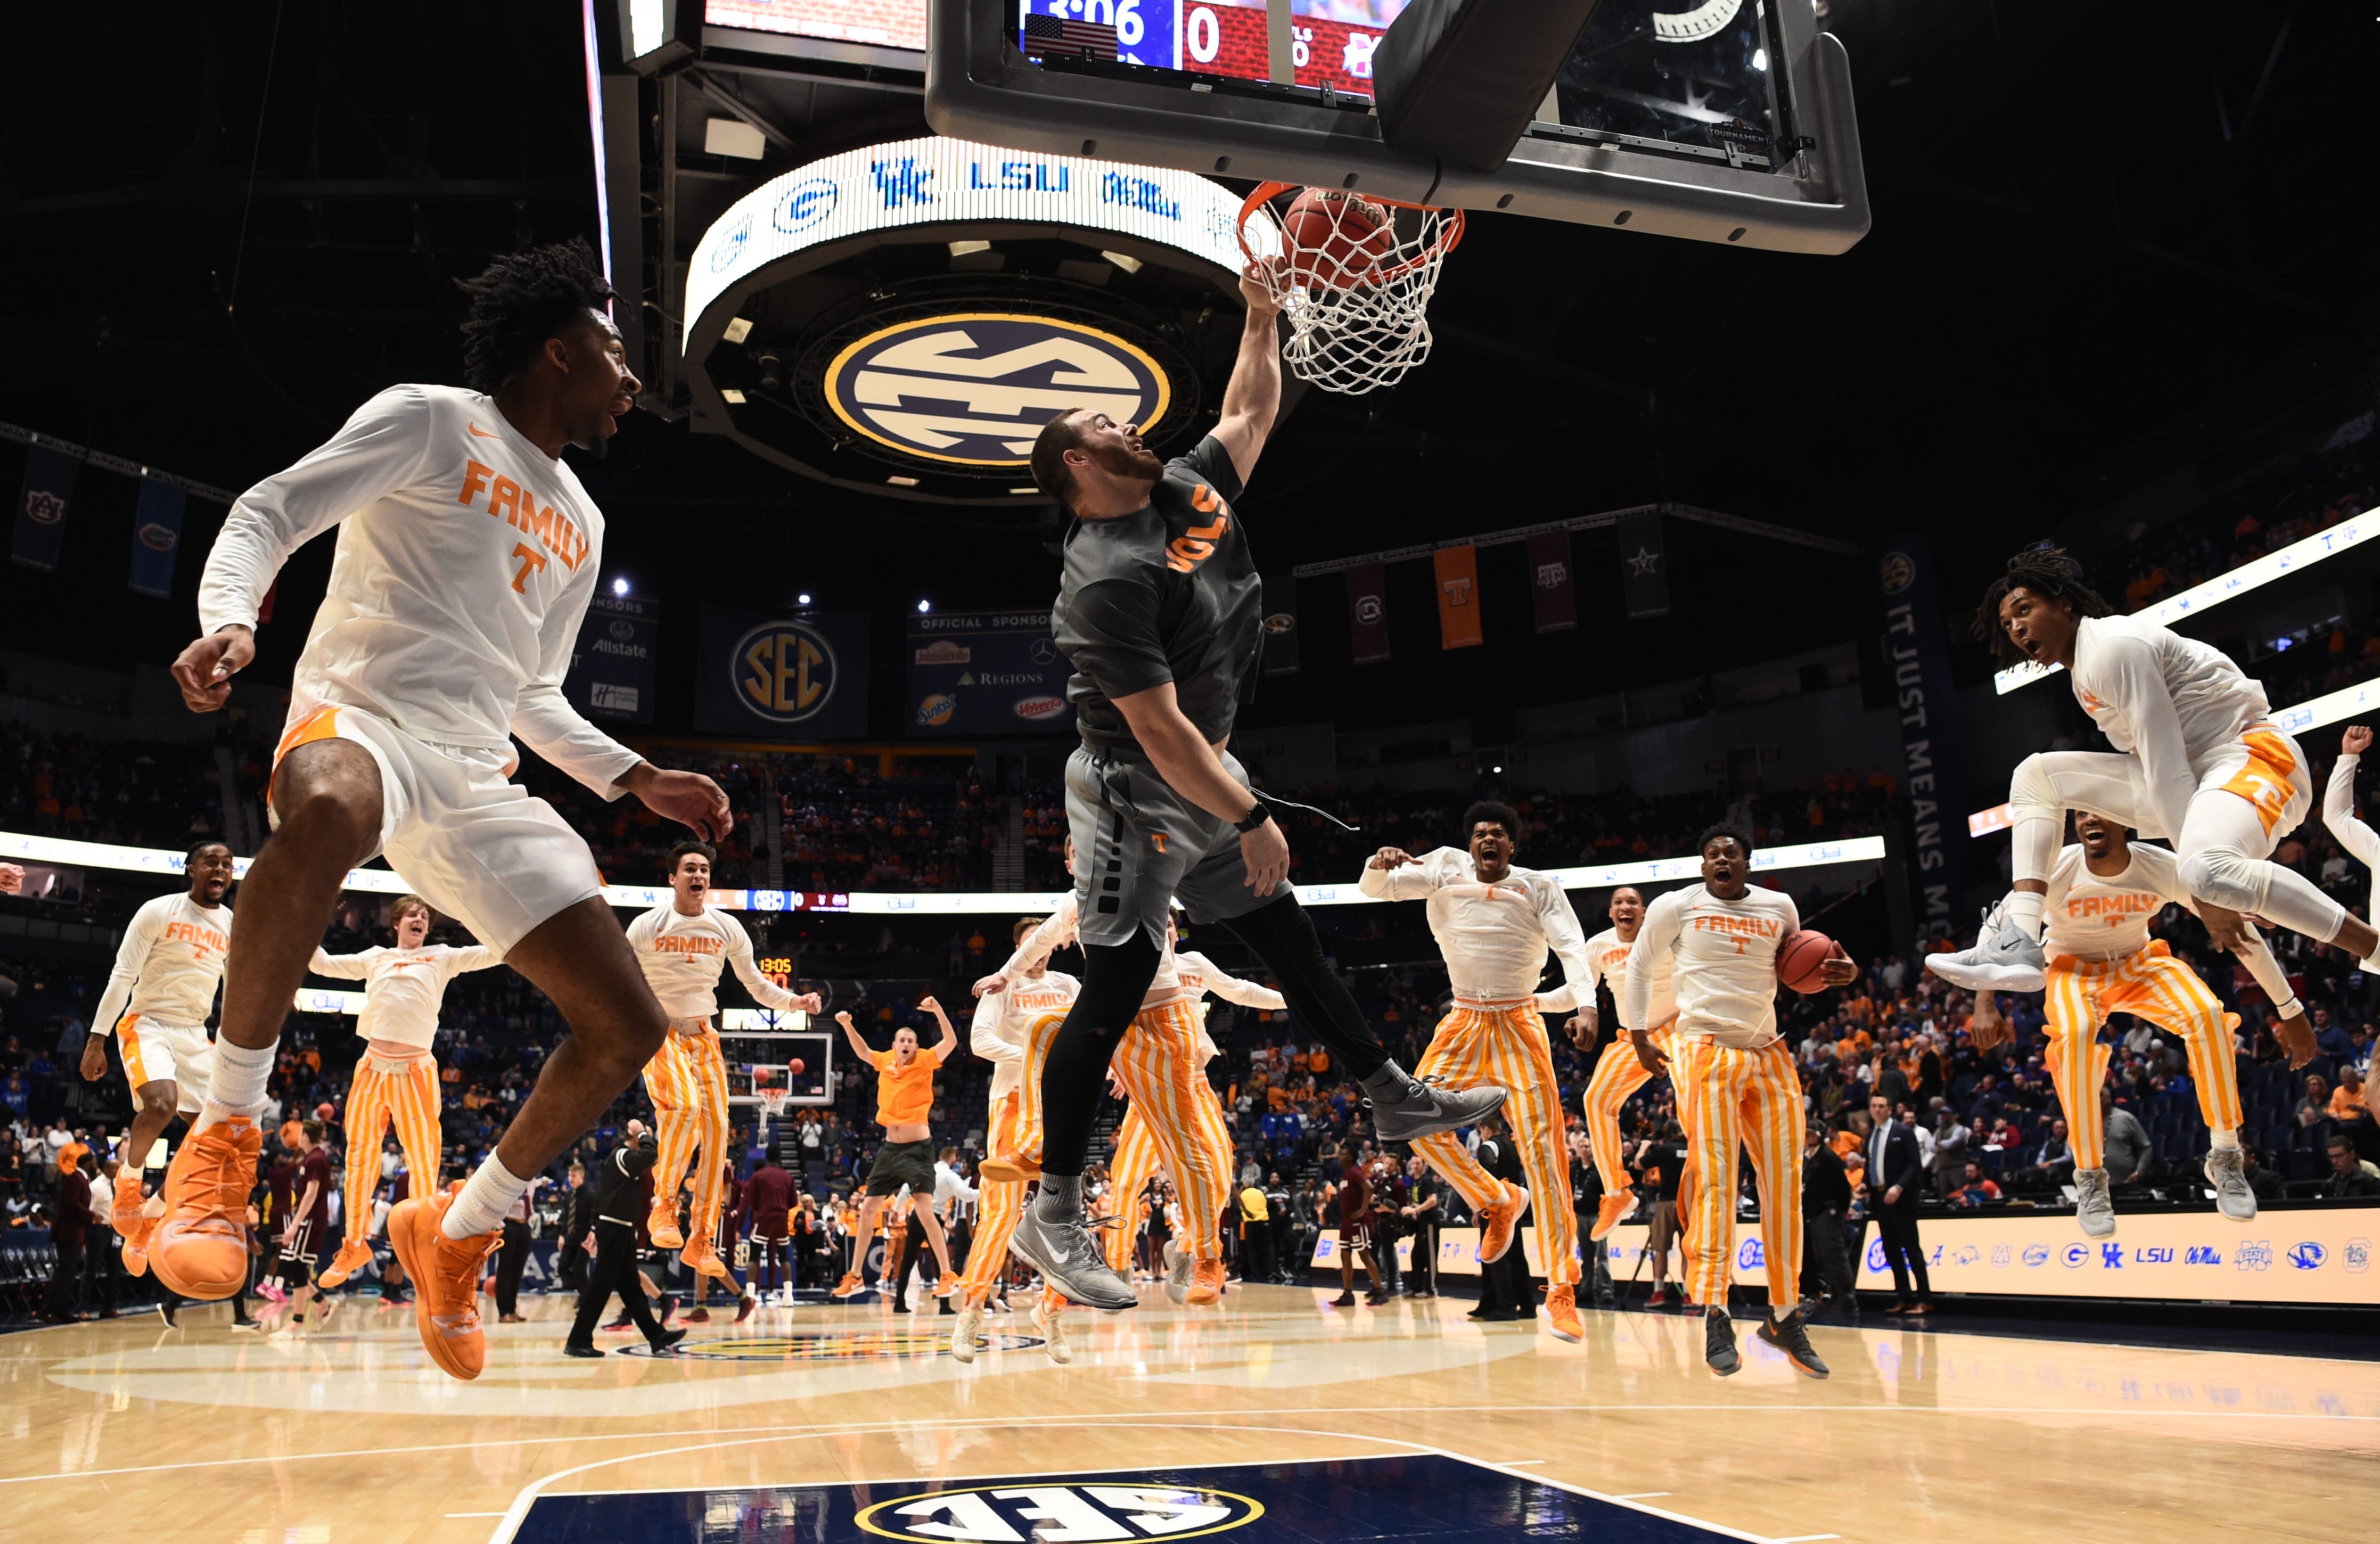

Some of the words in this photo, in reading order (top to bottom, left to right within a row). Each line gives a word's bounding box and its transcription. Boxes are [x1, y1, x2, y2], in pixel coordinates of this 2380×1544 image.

[1187, 6, 1220, 63] 0
[1708, 128, 1771, 146] TOURNAMENT
[971, 162, 1068, 192] LSU
[458, 459, 589, 576] FAMILY
[1165, 484, 1228, 573] VOLS
[512, 542, 547, 595] T
[921, 618, 982, 629] OFFICIAL
[992, 615, 1053, 627] SPONSO
[1887, 603, 1915, 636] IT
[592, 638, 647, 659] Allstate
[745, 634, 823, 711] SEC
[1892, 647, 1927, 728] JUST
[1905, 741, 1944, 872] MEANS
[1152, 833, 1169, 852] T
[2069, 894, 2159, 917] FAMILY
[1695, 916, 1779, 938] FAMILY
[655, 936, 723, 954] FAMILY
[1731, 937, 1750, 954] T
[760, 958, 791, 973] 13:05
[1014, 993, 1068, 1008] FAMILY
[2136, 1247, 2174, 1263] LSU
